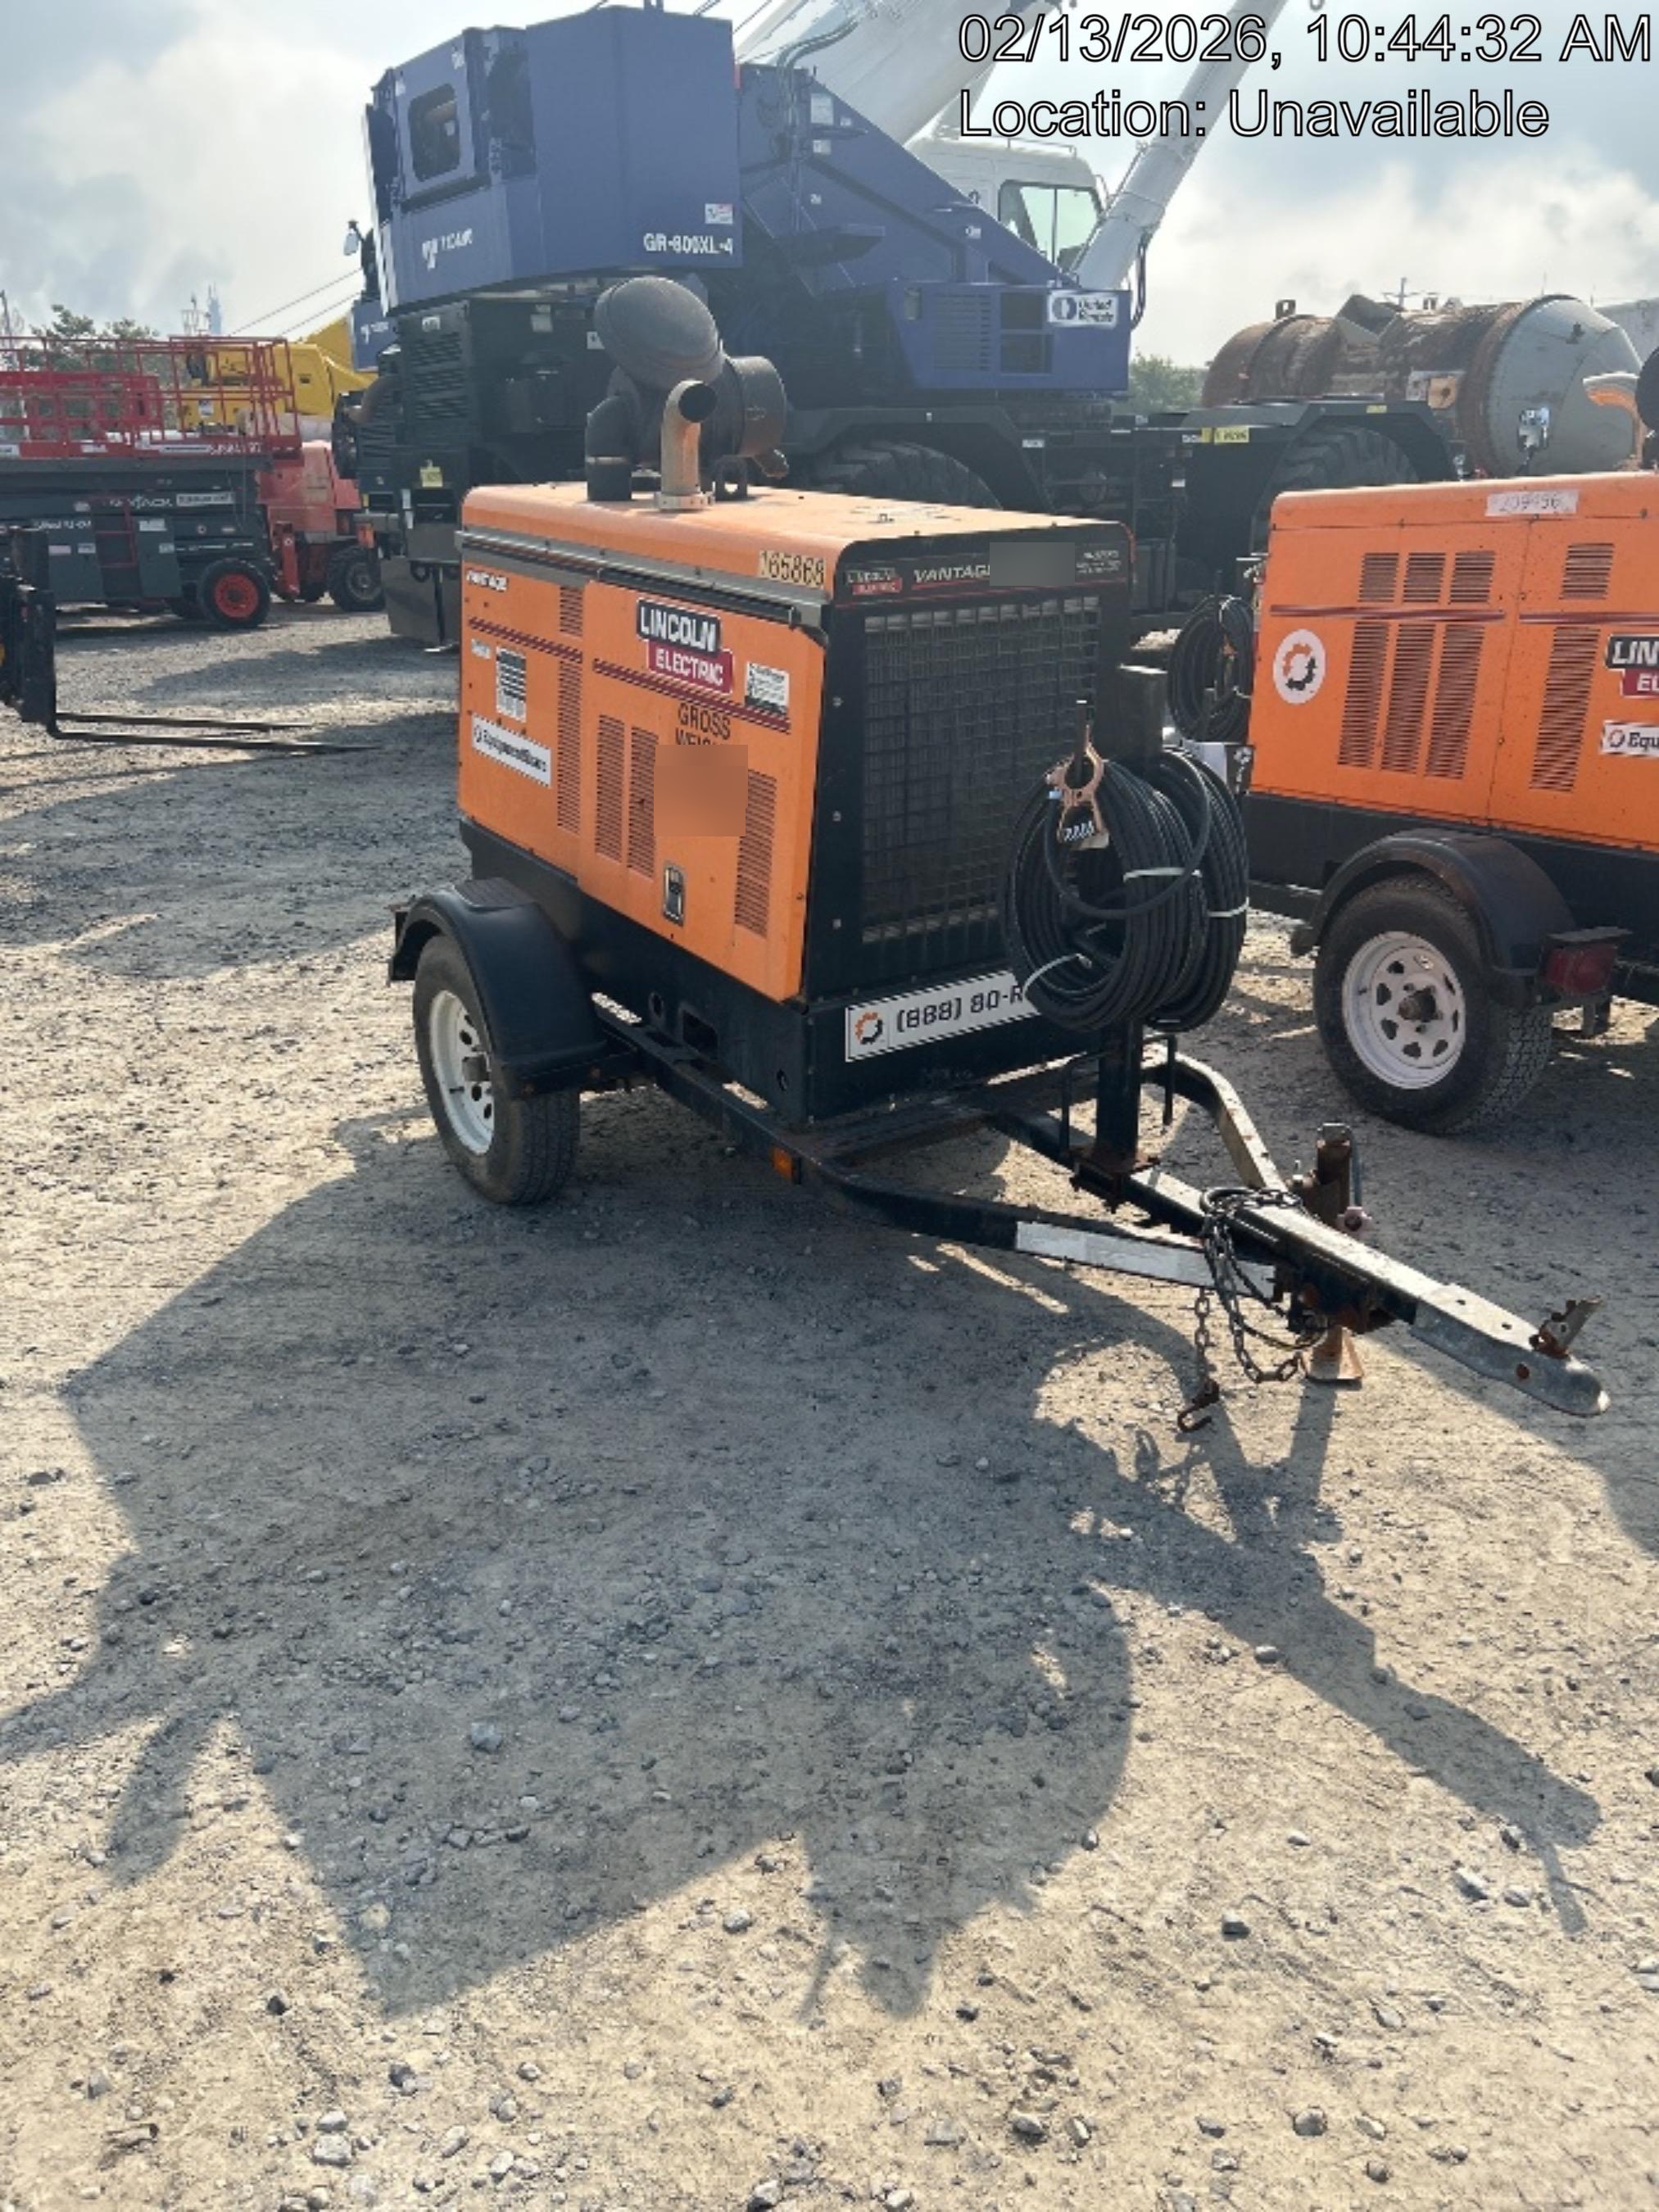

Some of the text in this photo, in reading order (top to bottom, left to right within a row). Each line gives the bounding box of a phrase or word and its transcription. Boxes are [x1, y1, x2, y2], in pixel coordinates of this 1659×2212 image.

[761, 550, 824, 586] 165868
[640, 606, 717, 652] LINCOLN
[655, 649, 723, 687] ELECTRIC
[678, 703, 731, 740] GROSS
[896, 997, 963, 1033] (888)
